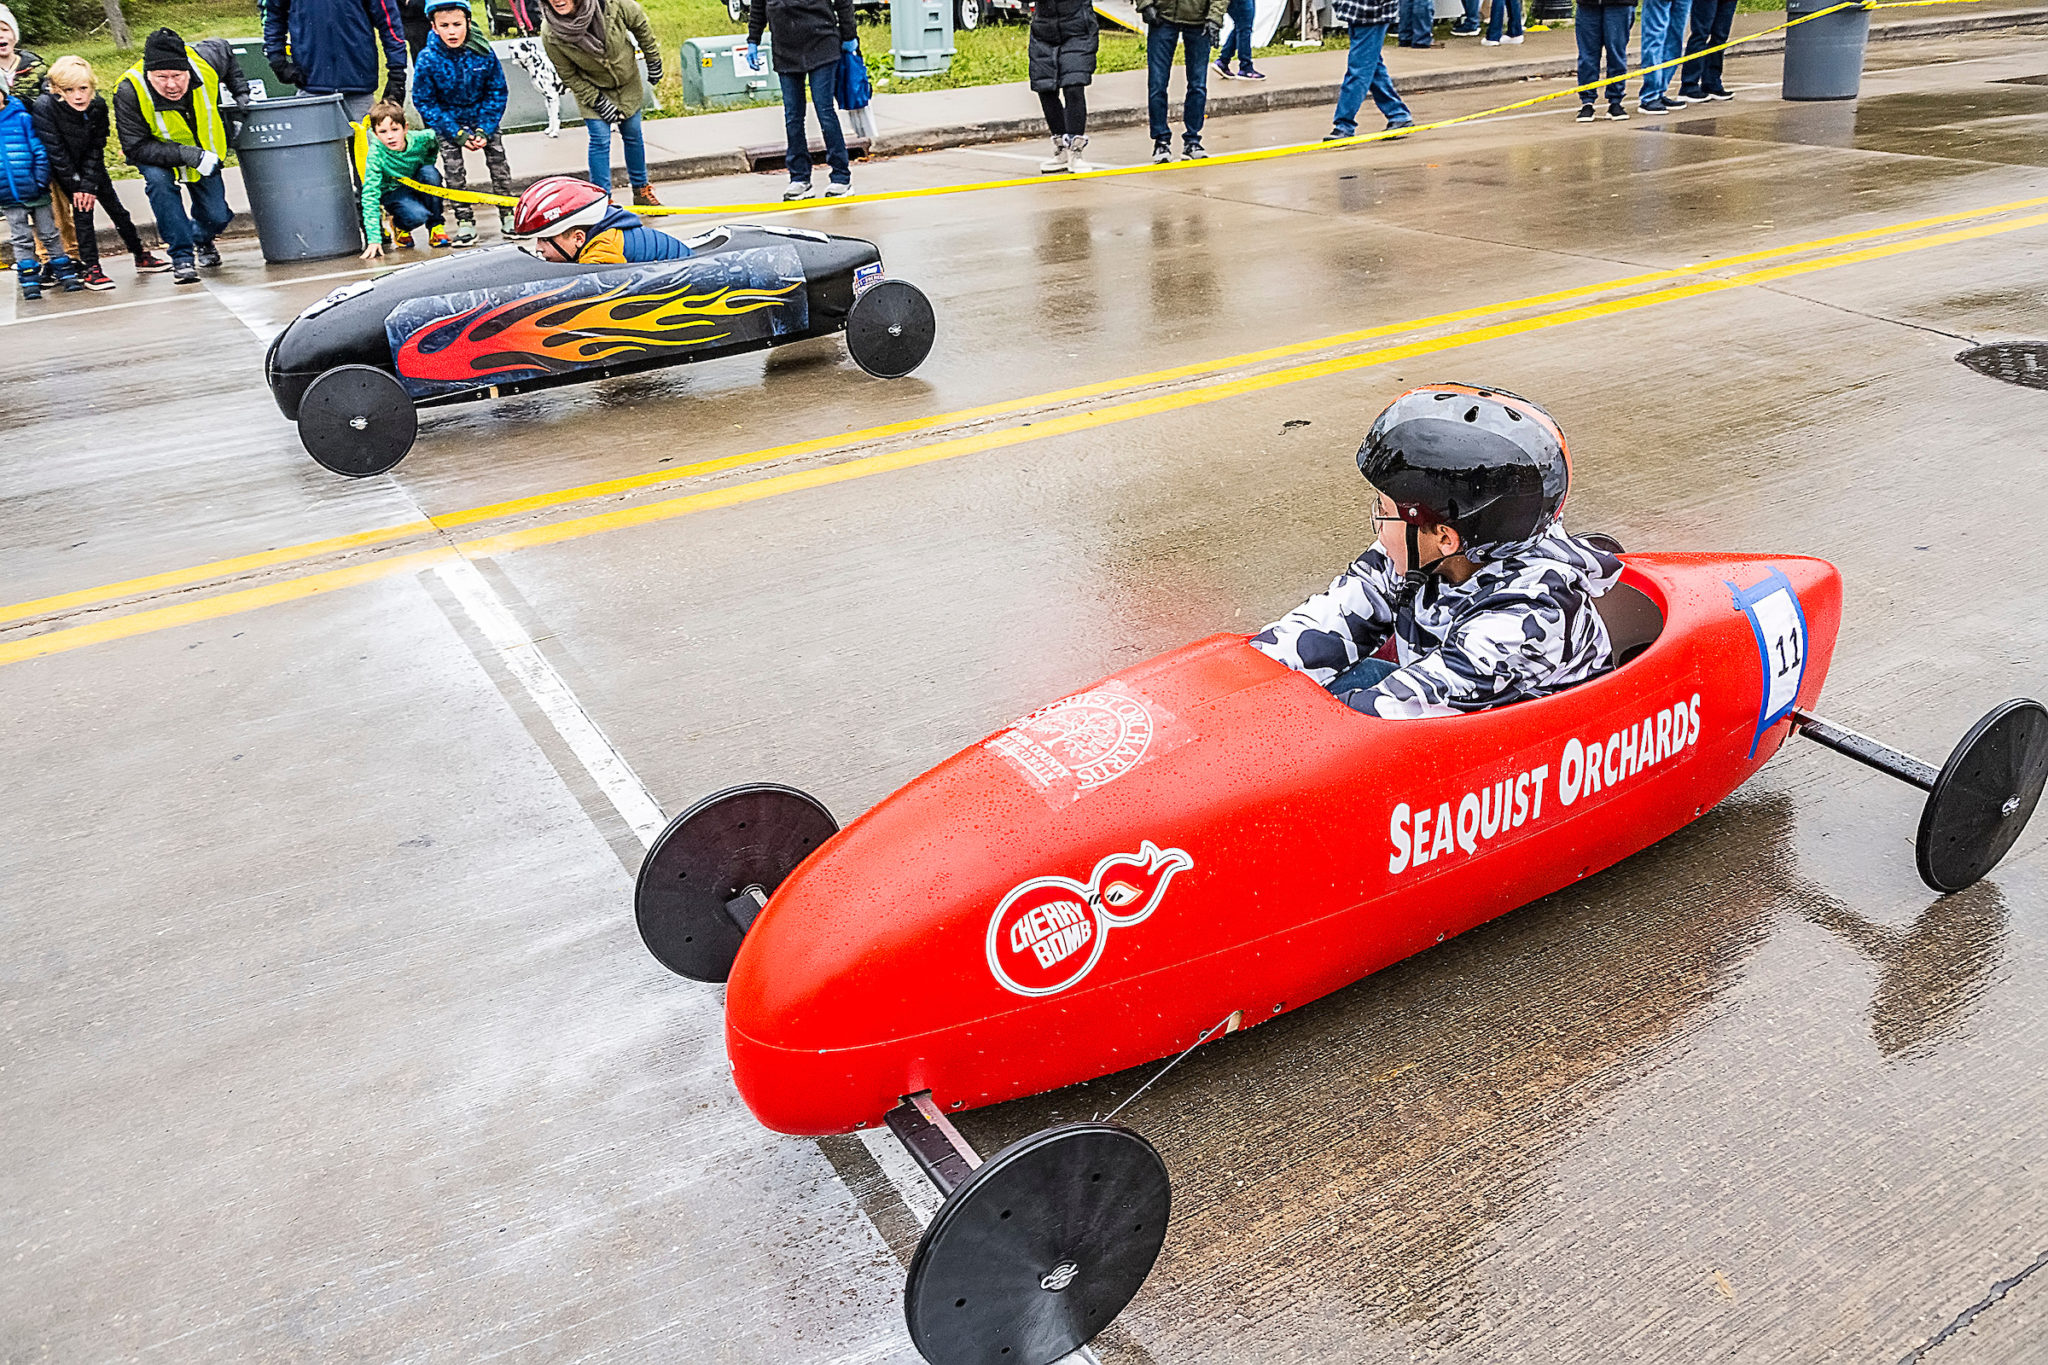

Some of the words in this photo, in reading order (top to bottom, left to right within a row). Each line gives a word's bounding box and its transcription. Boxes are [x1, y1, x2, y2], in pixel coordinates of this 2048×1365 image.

[249, 122, 292, 133] SISTER
[1776, 627, 1800, 677] 11
[1029, 744, 1072, 778] COUNTY
[1076, 703, 1149, 787] ORCHARDS
[1389, 764, 1549, 874] SEAQUIST
[1559, 693, 1701, 806] ORCHARDS
[1010, 900, 1085, 954] CHERRY
[1032, 919, 1093, 970] BOMB
